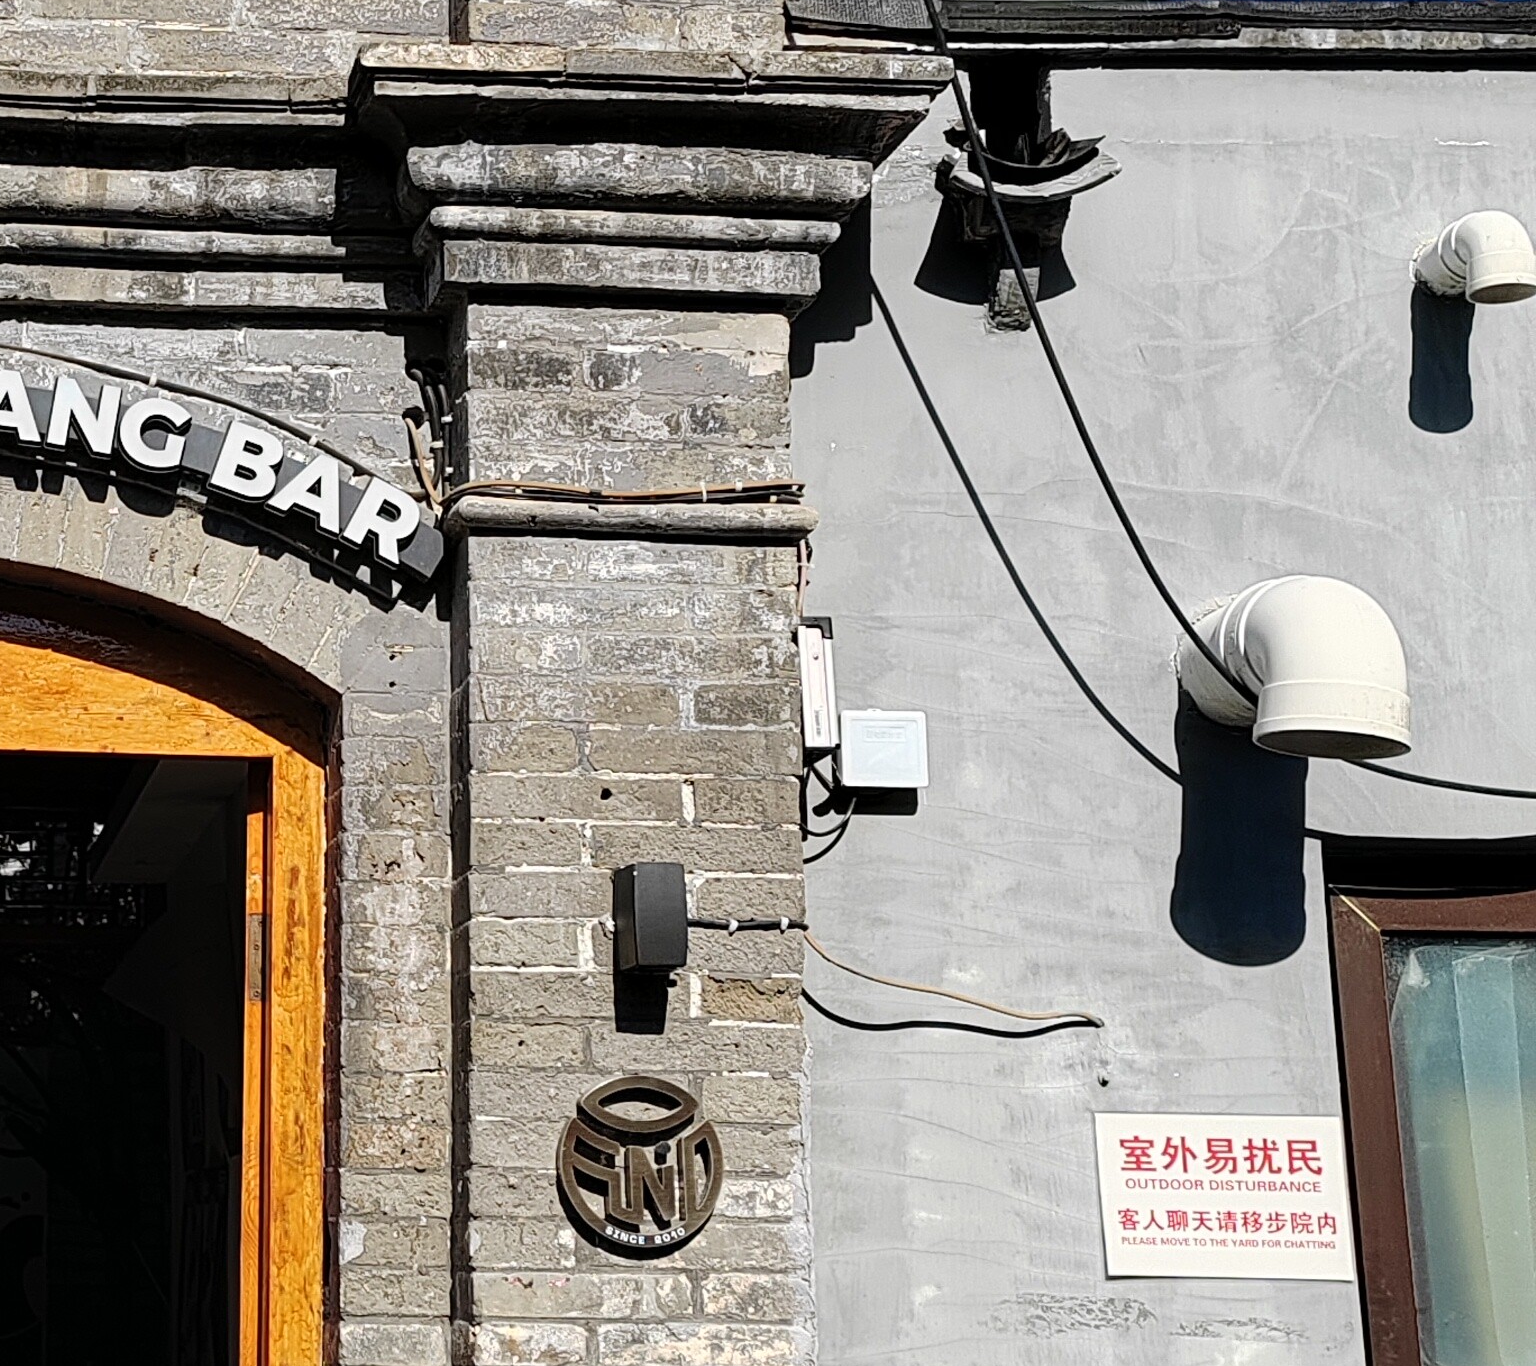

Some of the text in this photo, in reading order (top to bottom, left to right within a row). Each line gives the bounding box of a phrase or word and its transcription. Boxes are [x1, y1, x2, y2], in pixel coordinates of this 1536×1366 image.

[209, 419, 421, 566] BAR
[1118, 1135, 1324, 1177] 室外易扰民
[1124, 1178, 1322, 1193] OUTDOOR DISTURBANCE
[1117, 1207, 1339, 1235] 客人聊天请移步院内
[604, 1225, 646, 1245] SINCE
[1121, 1236, 1336, 1250] PLEASE MOVE TO THE YARD FOR CHATTING
